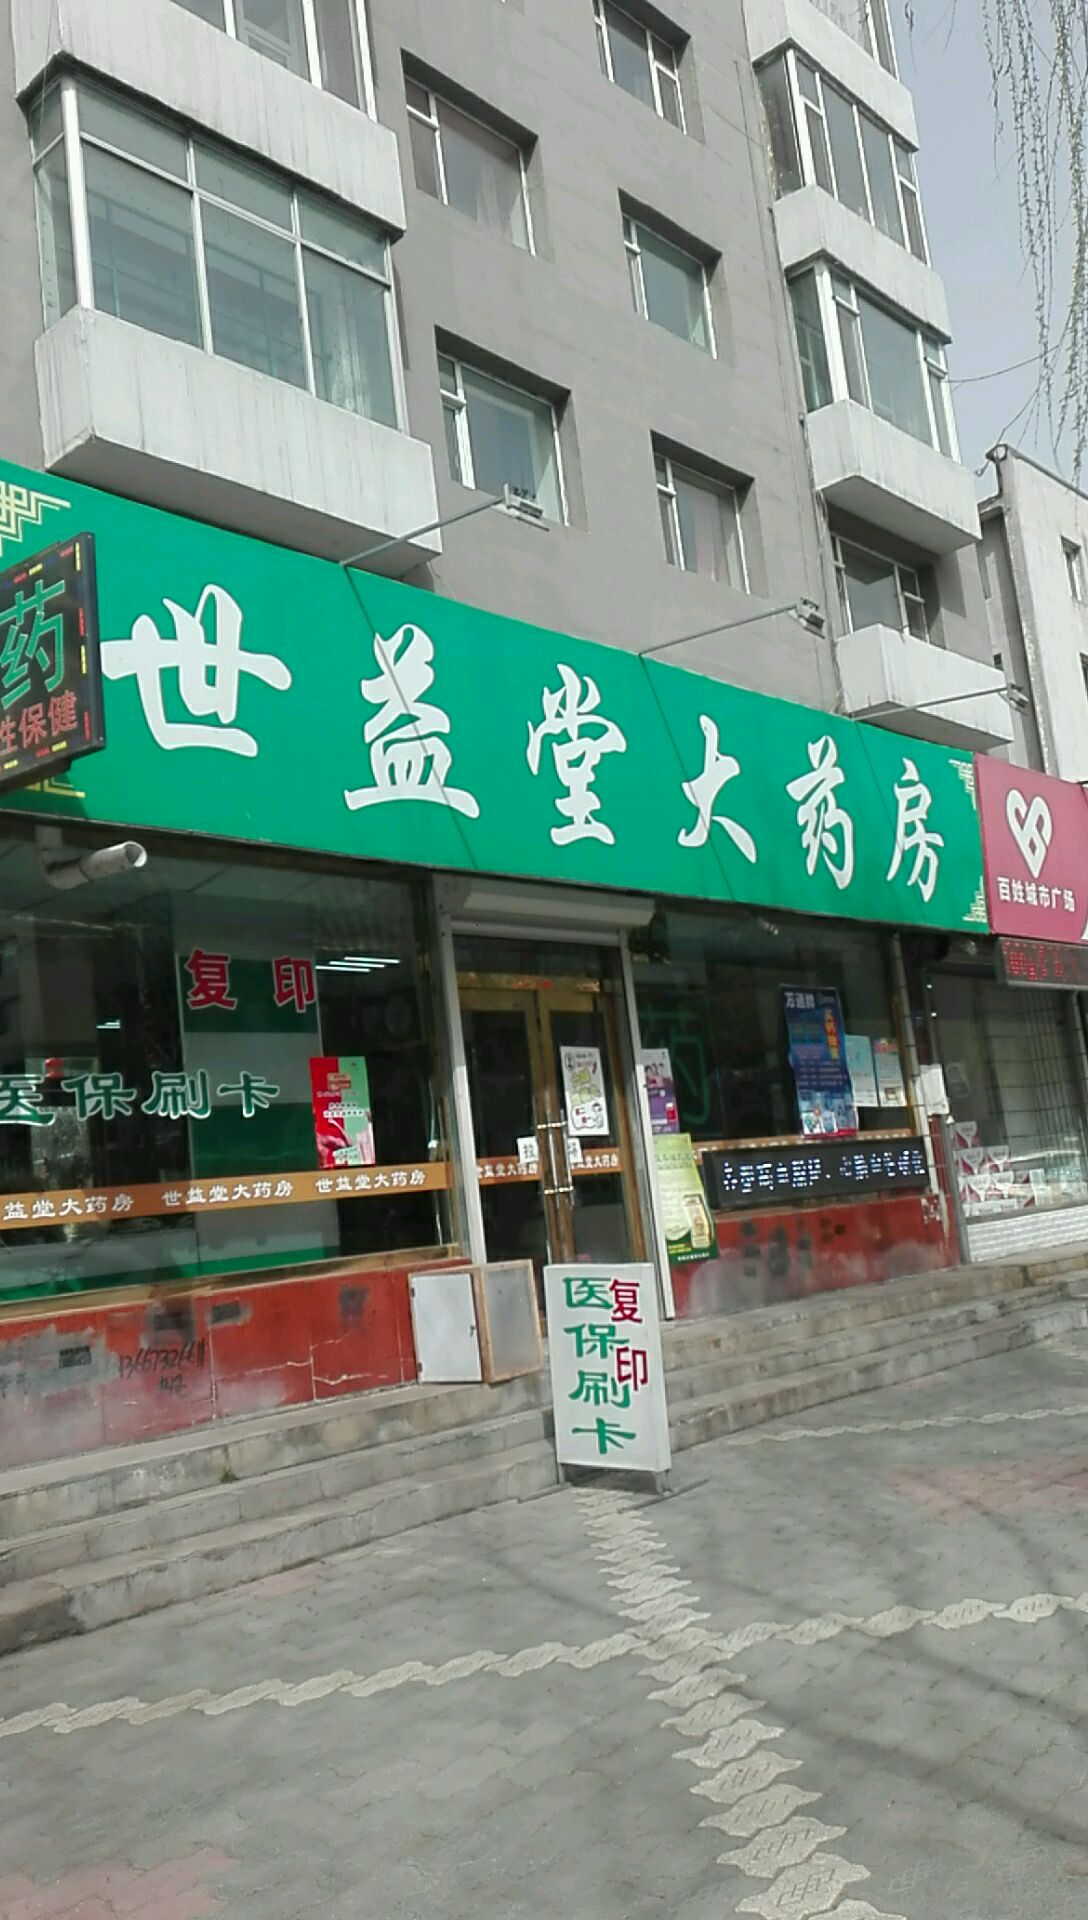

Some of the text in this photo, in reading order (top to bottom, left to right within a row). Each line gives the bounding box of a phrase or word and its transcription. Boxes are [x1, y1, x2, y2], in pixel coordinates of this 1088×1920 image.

[0, 579, 66, 710] 药
[100, 584, 945, 903] 世益堂大药房
[997, 876, 1076, 913] 百姓城市广场
[185, 948, 319, 1013] 复印
[0, 1068, 281, 1127] 医保刷卡
[2, 1193, 135, 1221] 益堂大药房
[162, 1178, 294, 1206] 世益堂大药房
[314, 1168, 427, 1194] 世益堂大药房
[562, 1276, 637, 1455] 医保刷卡
[608, 1278, 649, 1392] 复印
